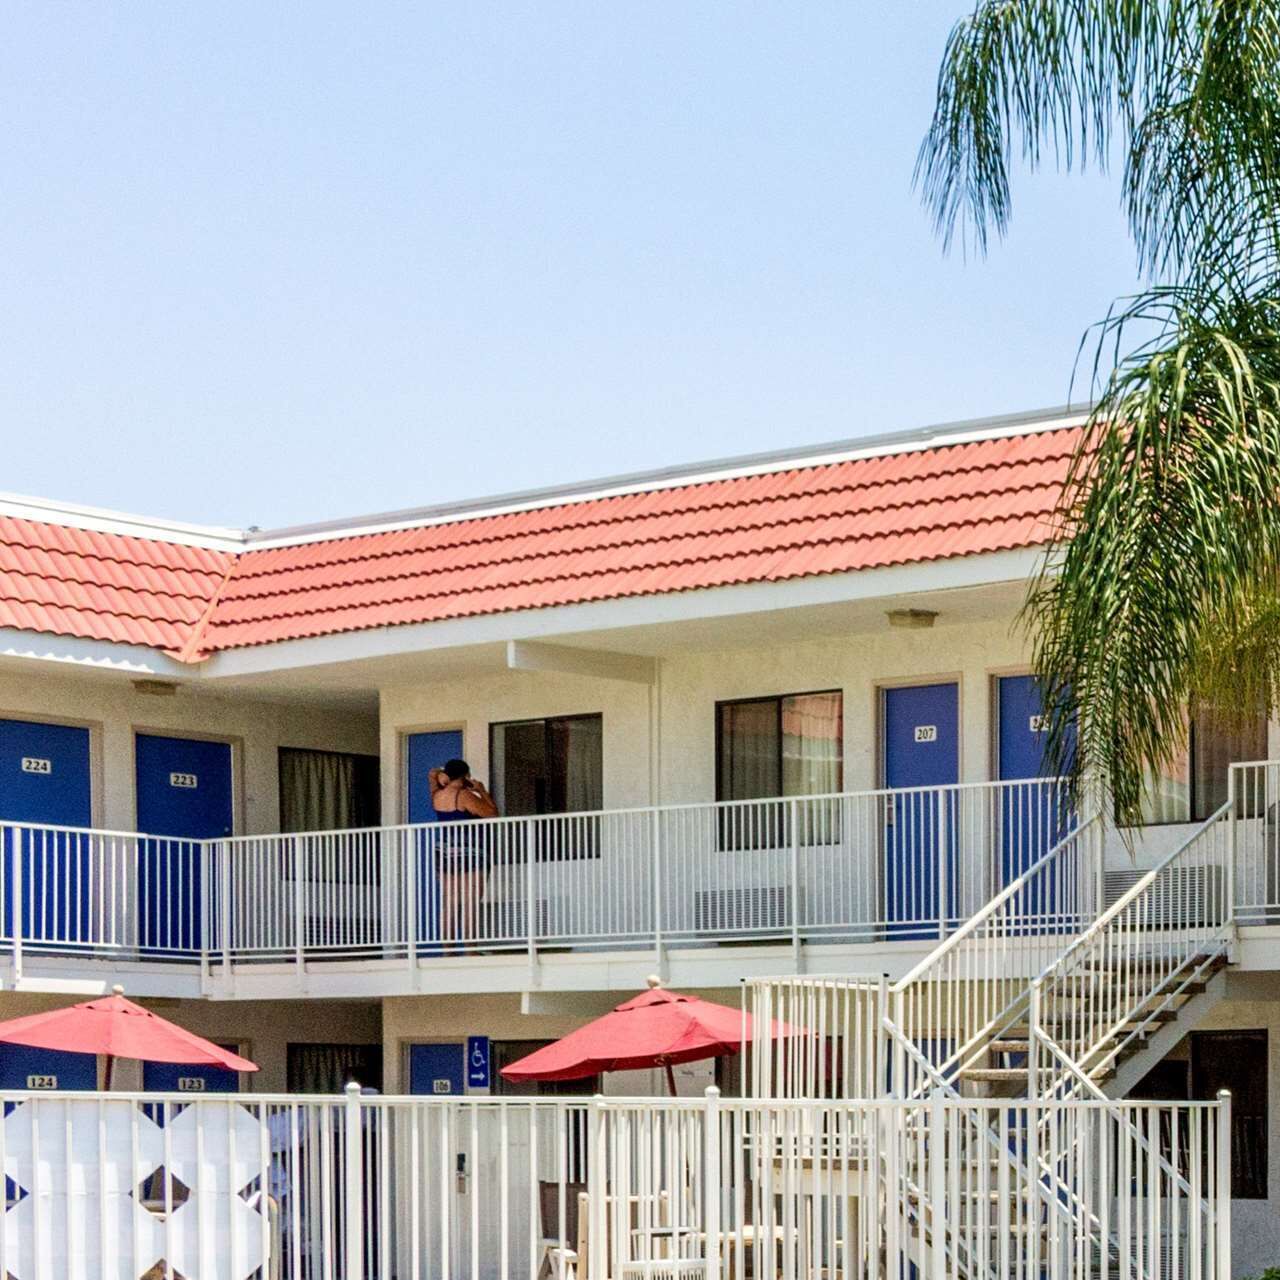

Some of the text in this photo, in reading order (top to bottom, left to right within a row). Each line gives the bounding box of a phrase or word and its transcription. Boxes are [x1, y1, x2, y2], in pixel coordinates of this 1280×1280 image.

[917, 728, 934, 740] 207
[25, 760, 48, 772] 224
[173, 775, 195, 786] 223
[30, 1076, 53, 1087] 124
[182, 1080, 202, 1090] 123
